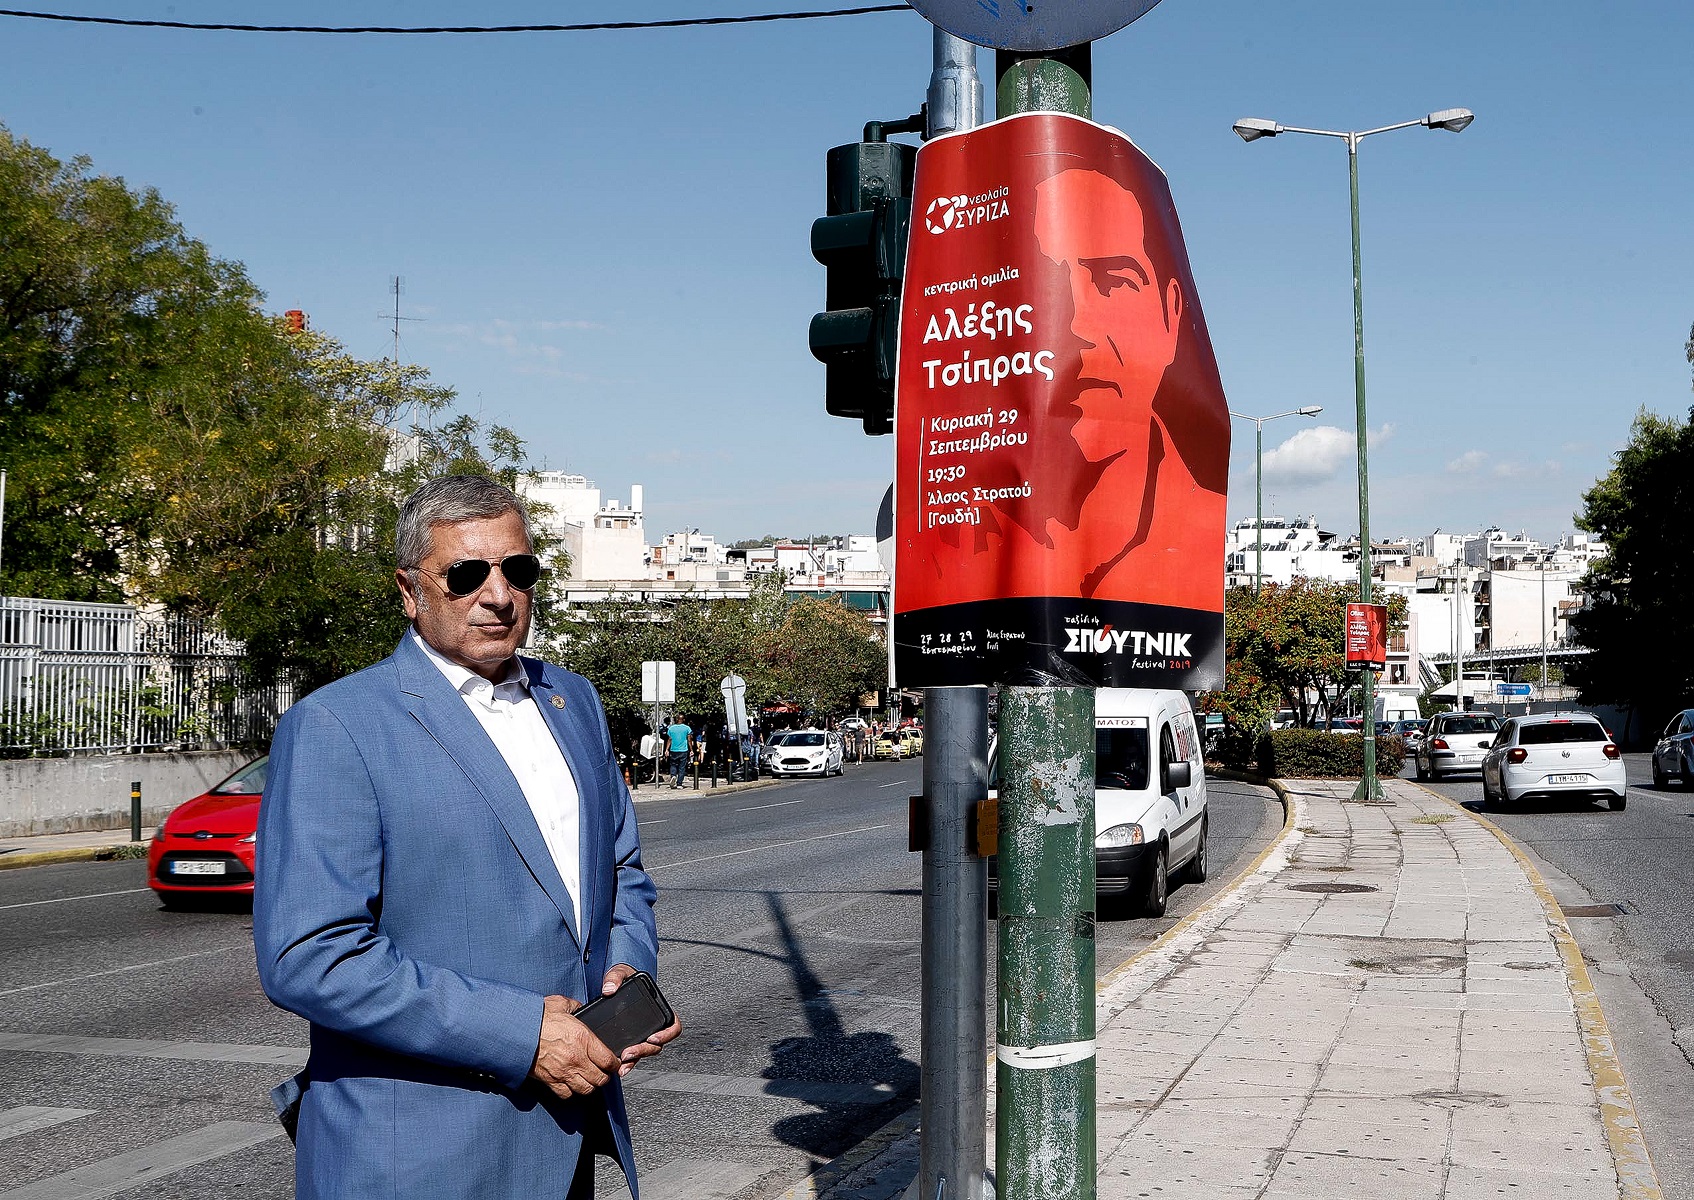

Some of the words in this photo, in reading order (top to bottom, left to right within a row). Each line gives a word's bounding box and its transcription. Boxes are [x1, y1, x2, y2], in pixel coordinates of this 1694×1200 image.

[969, 186, 1009, 205] νεολαία
[955, 200, 1010, 229] ΣΥΡΙΖΑ
[924, 274, 978, 297] κεντρική
[981, 266, 1020, 287] ομιλία
[922, 301, 1034, 345] Αλέξης
[922, 350, 1056, 389] Τσίπρας
[931, 407, 994, 434] Κυριακή
[998, 409, 1018, 425] 29
[929, 429, 1028, 455] Σεπτεμβρίου
[927, 465, 966, 483] 19:30
[927, 490, 968, 506] Άλσος
[972, 481, 1032, 502] Στρατού
[928, 507, 980, 528] [Γουδή]
[921, 634, 932, 645] 27
[940, 633, 952, 643] 28
[959, 630, 973, 642] 29
[1131, 657, 1166, 669] festival
[1169, 660, 1191, 669] 2019
